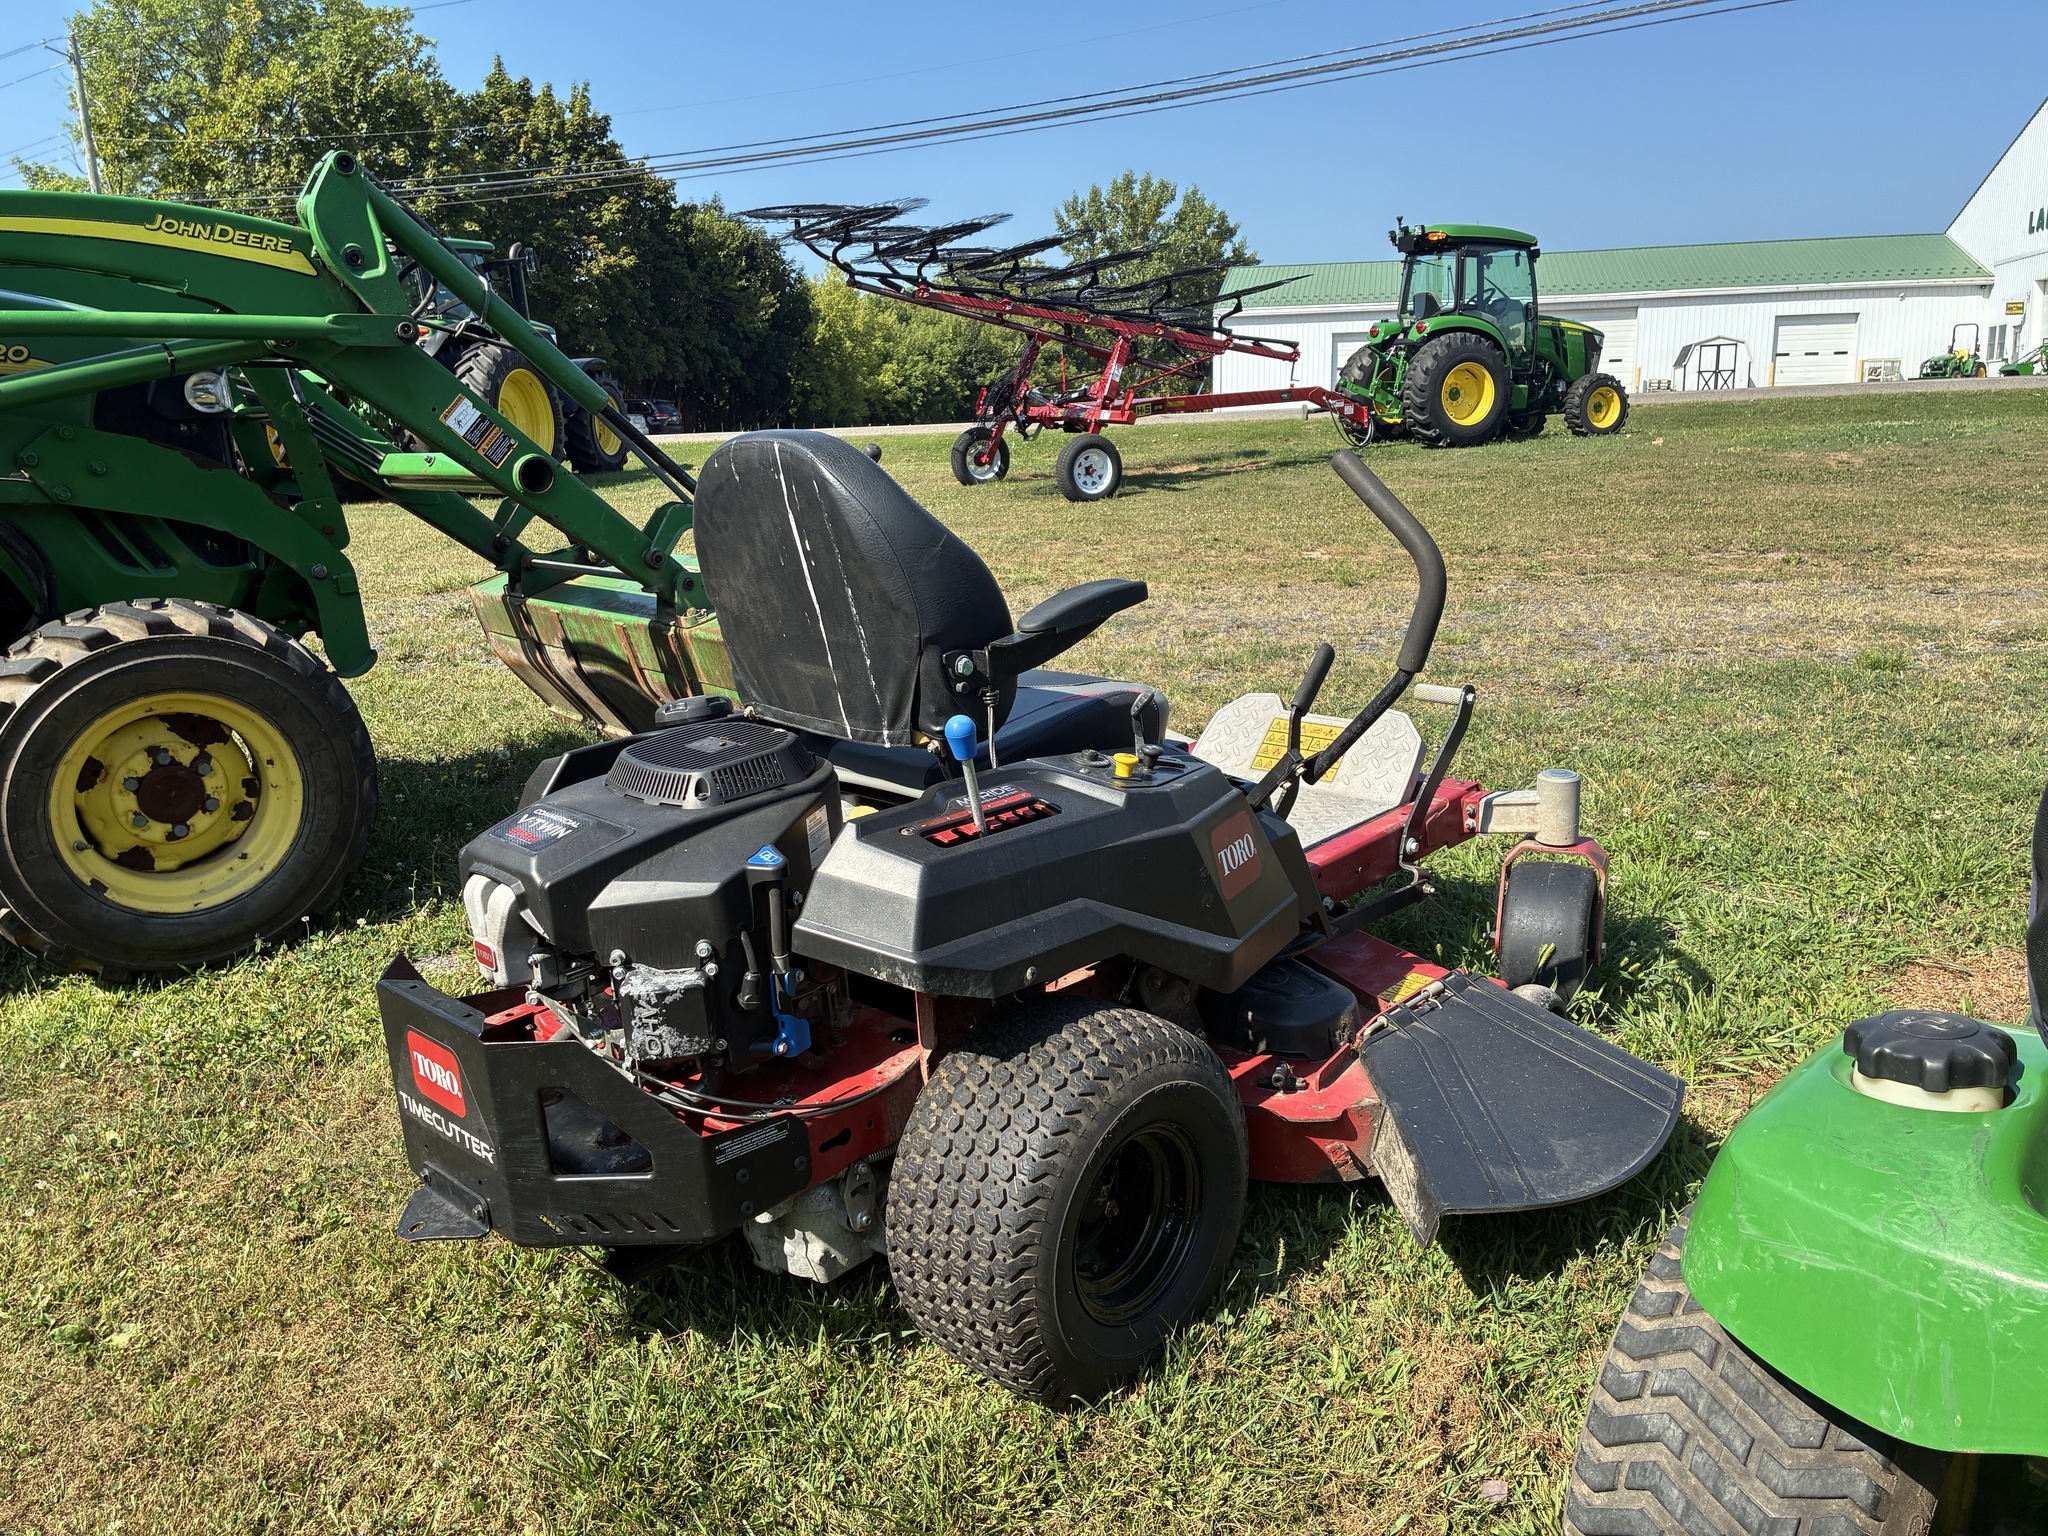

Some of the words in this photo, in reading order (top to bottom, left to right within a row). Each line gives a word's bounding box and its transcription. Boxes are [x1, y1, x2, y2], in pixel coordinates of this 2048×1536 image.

[144, 213, 214, 240] JOHN
[213, 223, 293, 254] DEERE
[2028, 205, 2048, 234] LA
[956, 784, 1016, 807] MRIDE
[533, 808, 580, 828] COMMERCIAL
[1217, 833, 1255, 877] TORO
[640, 999, 663, 1056] OHV
[413, 1050, 460, 1096] TORO
[399, 1090, 494, 1165] TIMECUTTER
